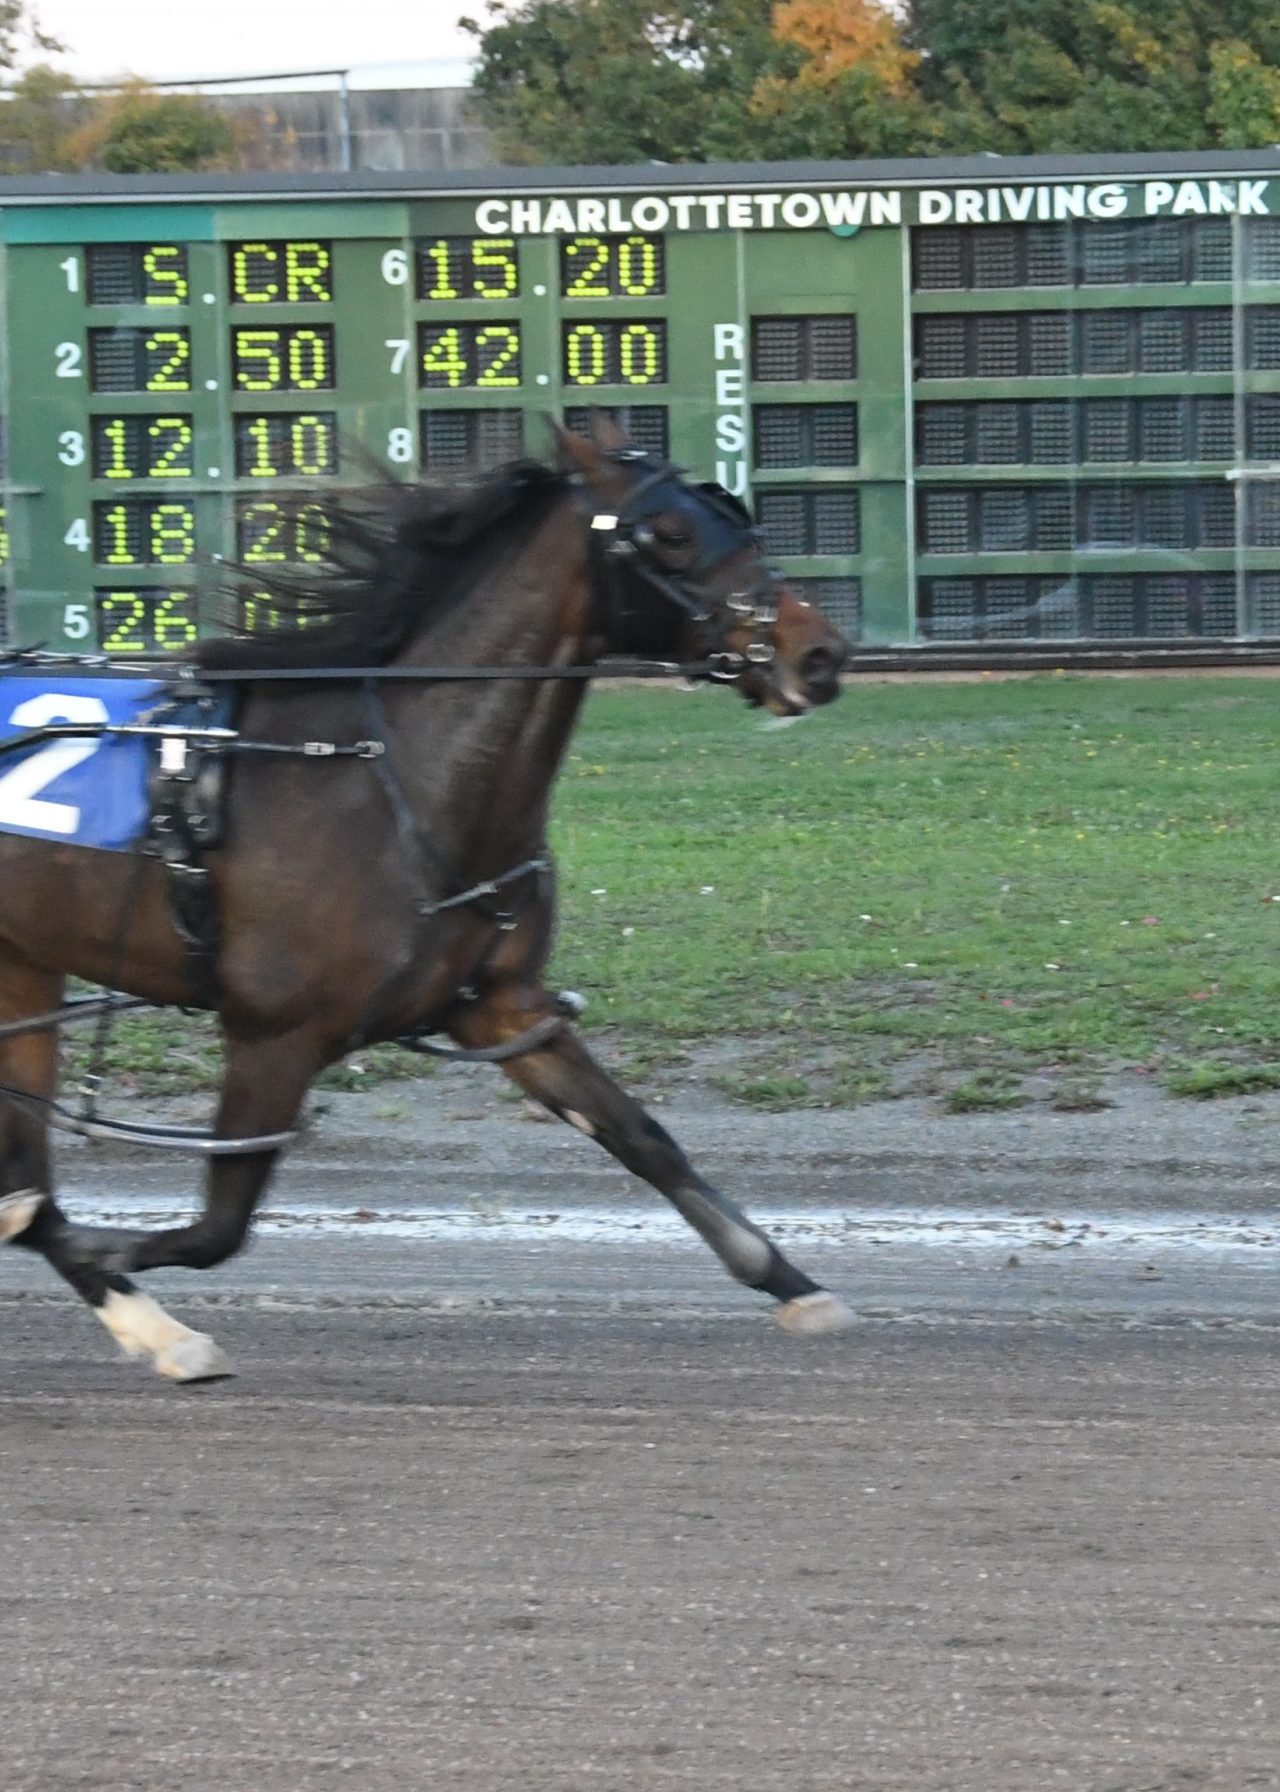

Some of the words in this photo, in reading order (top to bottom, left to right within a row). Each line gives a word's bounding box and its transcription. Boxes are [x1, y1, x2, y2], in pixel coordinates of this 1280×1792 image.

[475, 191, 902, 234] CHARLOTTETOWN
[918, 183, 1128, 224] DRIVING
[1144, 180, 1270, 215] PARK
[59, 256, 79, 293] 1
[381, 249, 410, 286] 6
[54, 341, 83, 379] 2
[384, 338, 413, 375] 7
[58, 430, 85, 467] 3
[387, 427, 415, 463] 8
[64, 518, 91, 552] 4
[63, 604, 90, 639] 5
